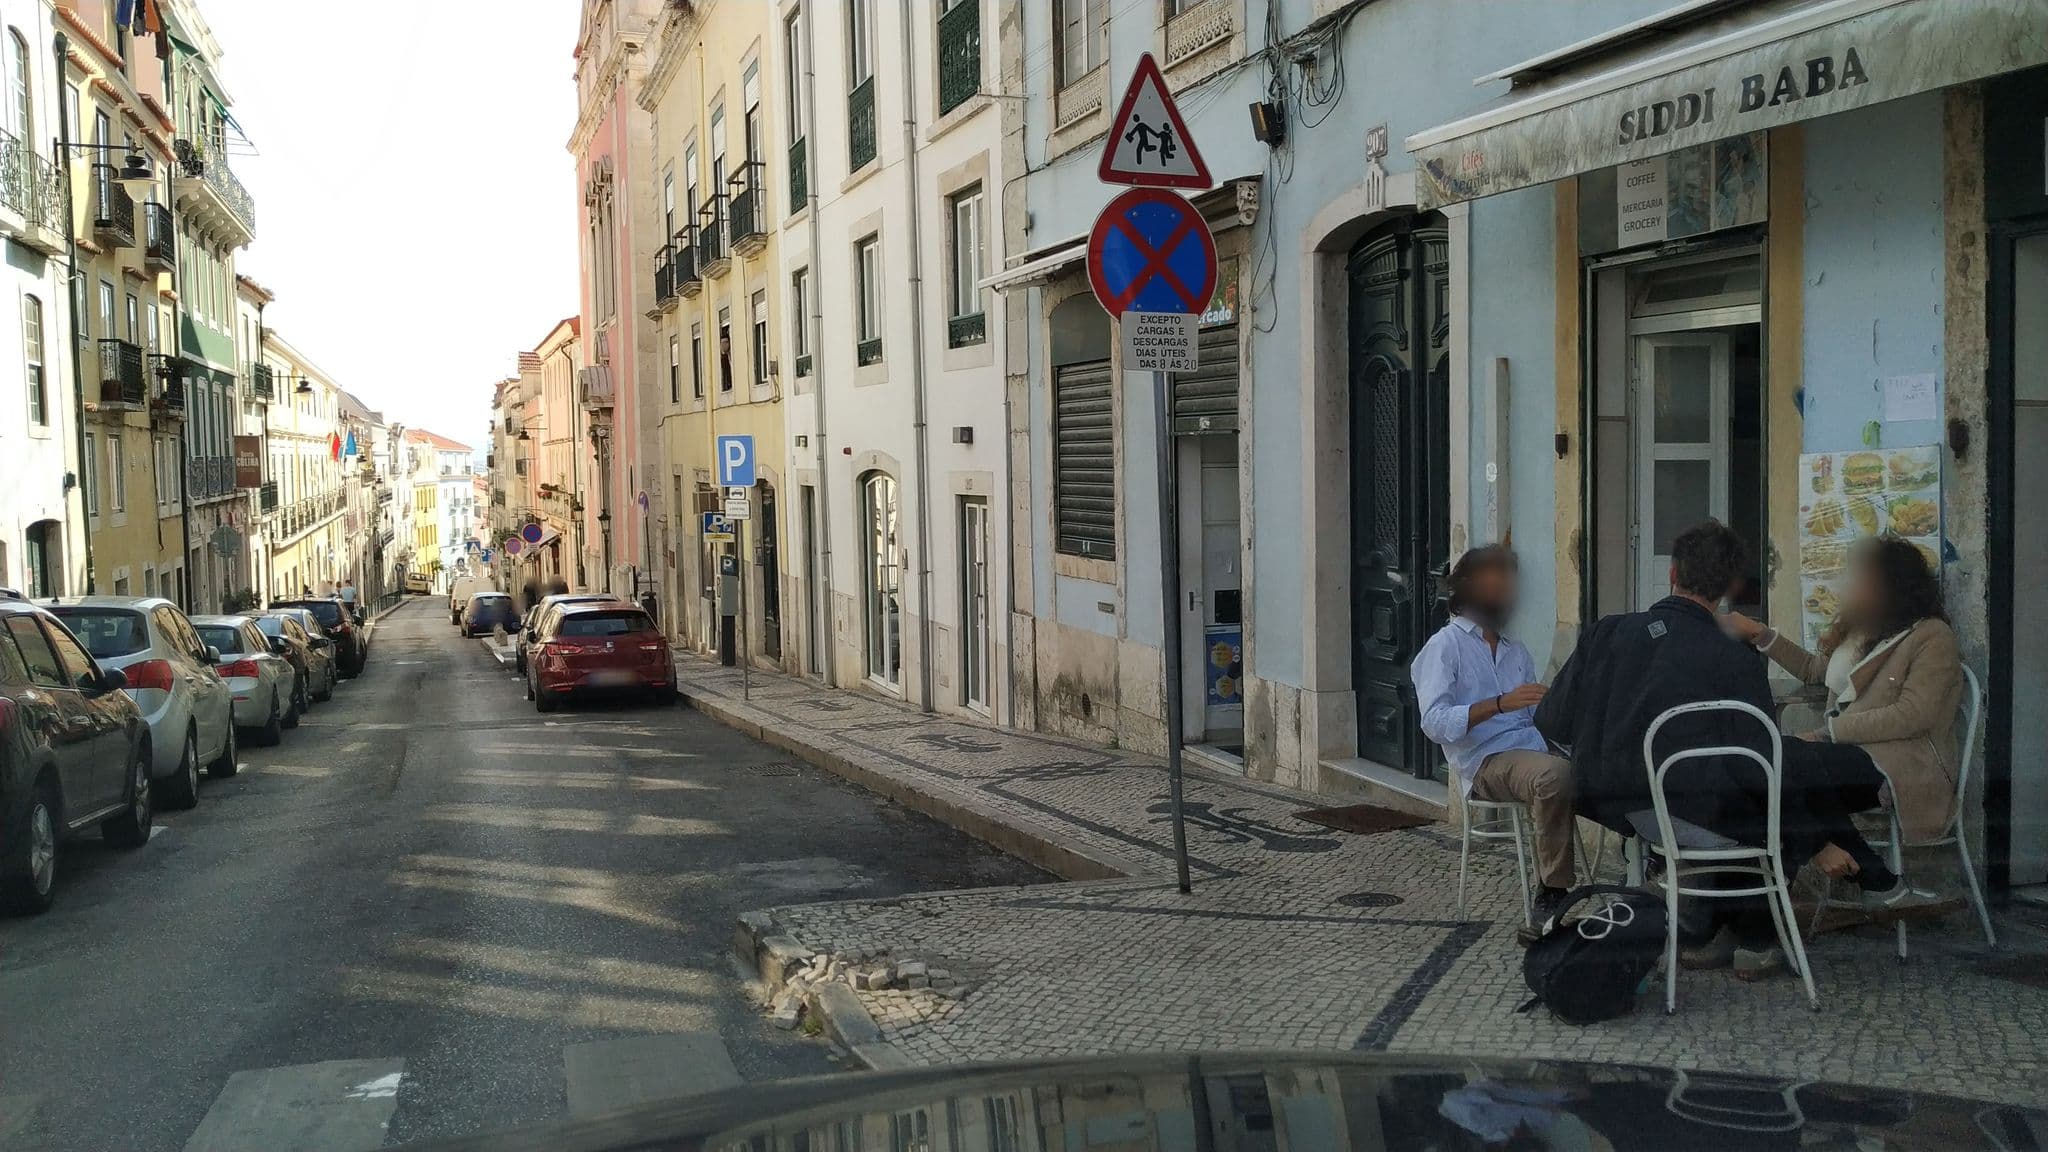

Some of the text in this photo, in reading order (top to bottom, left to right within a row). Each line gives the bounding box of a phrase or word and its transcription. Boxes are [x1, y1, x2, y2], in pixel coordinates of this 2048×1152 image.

[1618, 46, 1870, 145] SIDDI BABA
[1626, 172, 1656, 188] COFFEE
[1622, 198, 1664, 214] MERCEARIA
[1623, 216, 1662, 233] GROCERY
[1140, 315, 1182, 325] EXCEPTO
[1136, 327, 1185, 336] CARGAS E
[1133, 337, 1189, 347] DESCARGAS
[1136, 347, 1186, 358] DIAS ÚTEIS
[1139, 359, 1157, 368] DAS
[1159, 359, 1166, 370] 8
[1184, 359, 1197, 370] 20
[725, 440, 746, 482] P
